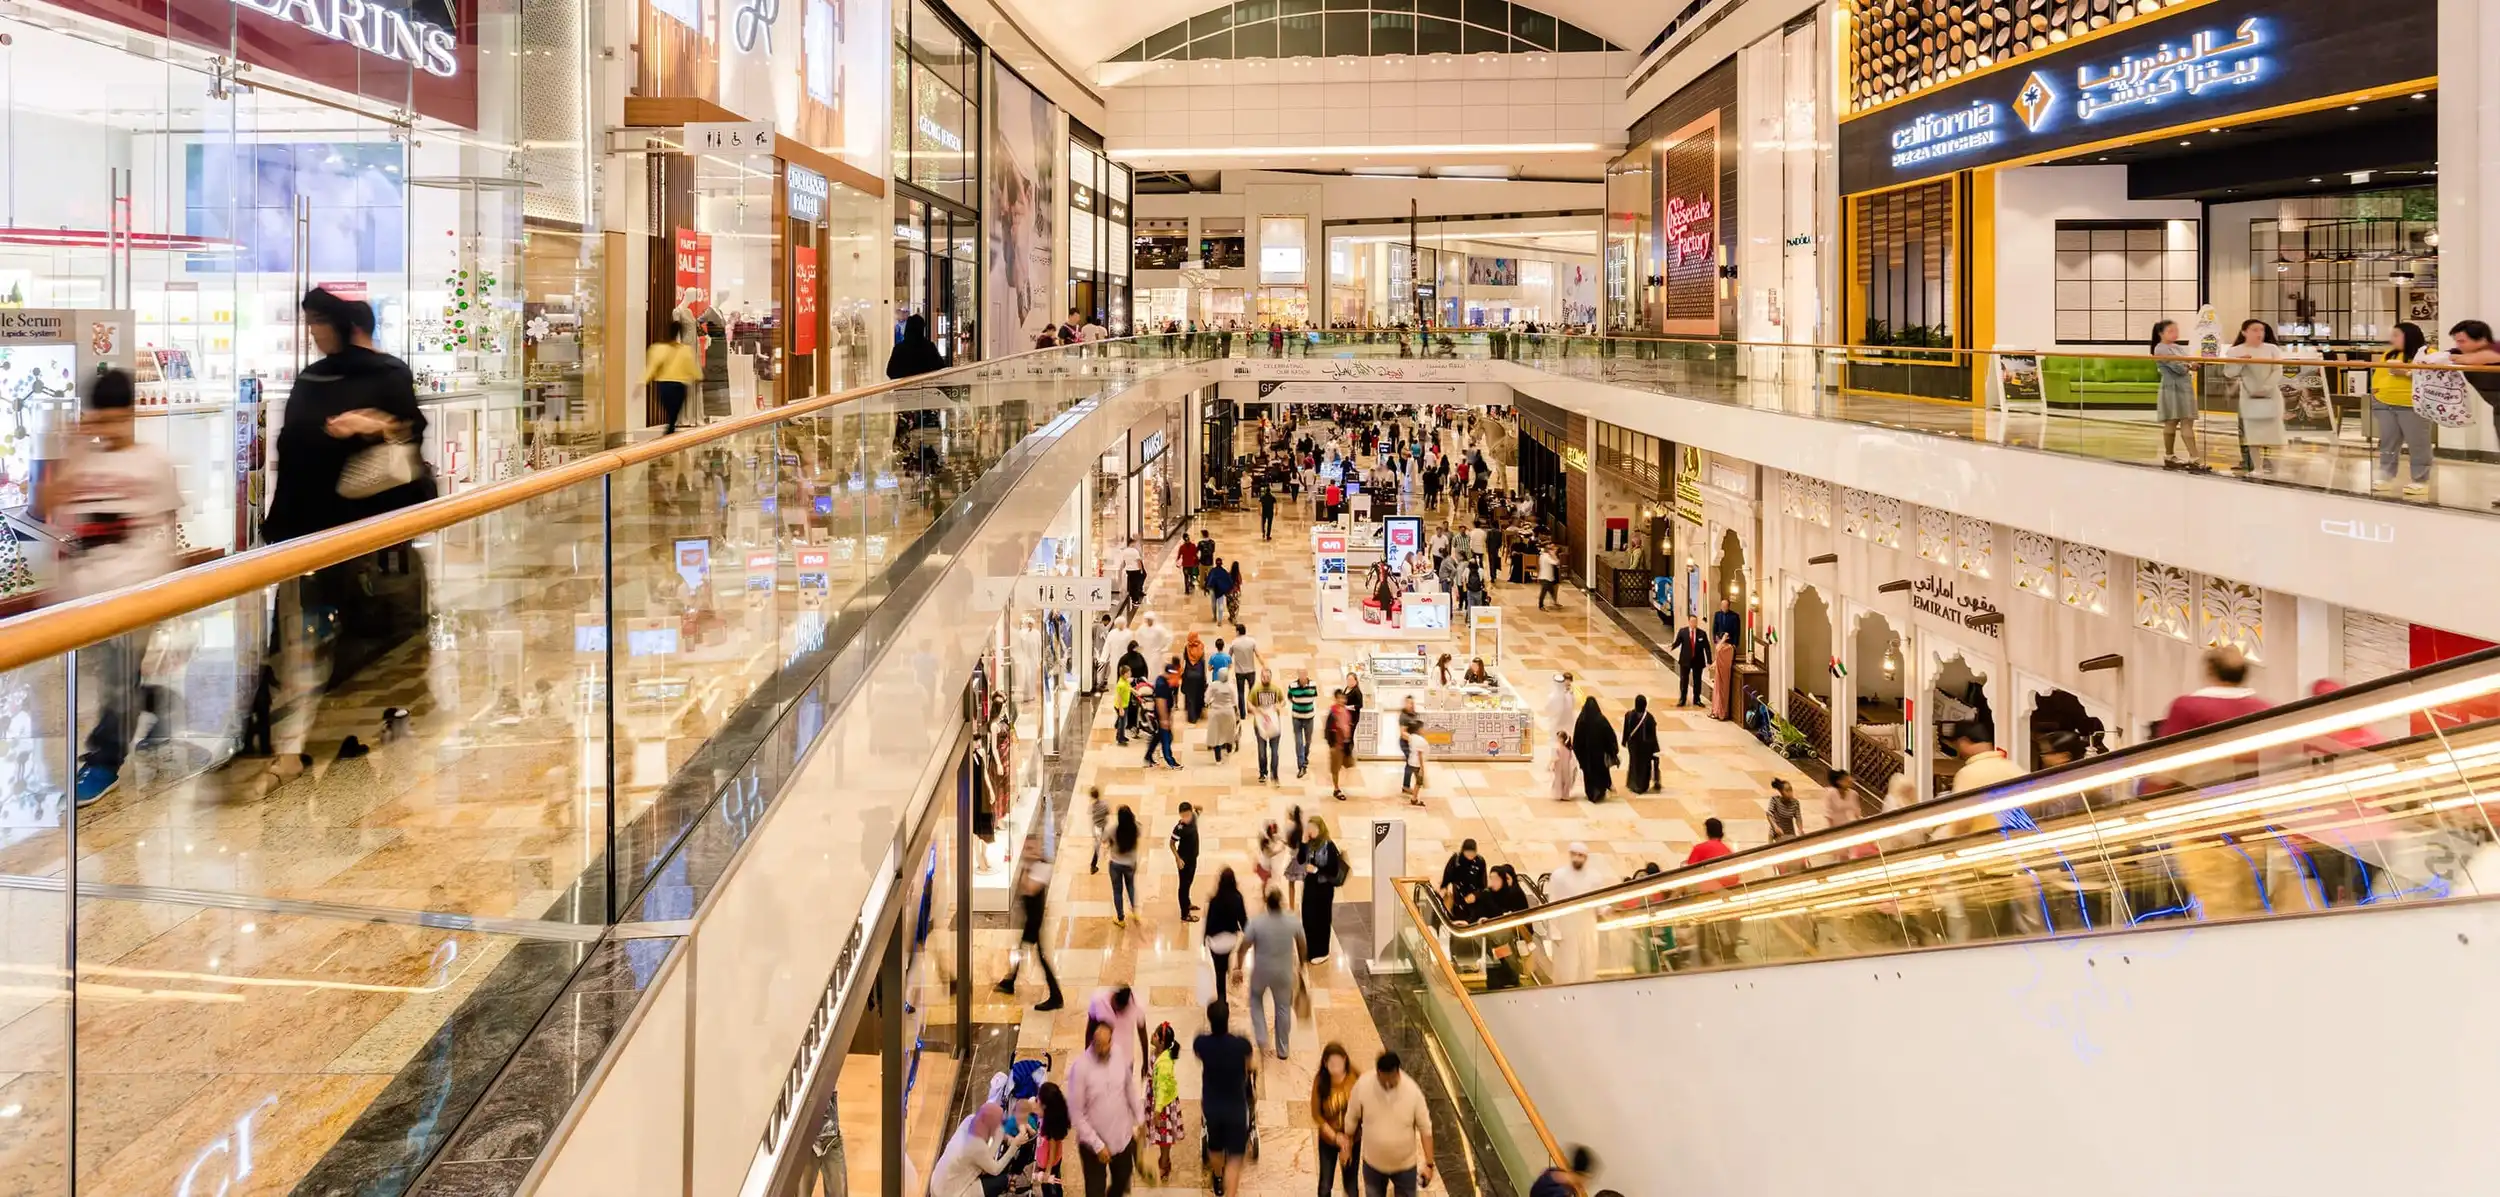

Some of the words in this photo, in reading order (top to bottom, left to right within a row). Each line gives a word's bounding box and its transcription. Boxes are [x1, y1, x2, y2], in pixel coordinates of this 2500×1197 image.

[1892, 100, 1995, 149] california
[1932, 130, 1995, 157] KITCHEN
[1667, 193, 1712, 241] Cheesecake
[680, 238, 697, 251] PART
[1674, 226, 1711, 267] Factory
[679, 254, 705, 273] SALE
[17, 312, 62, 327] Serum
[1260, 383, 1274, 393] GF
[1913, 595, 1961, 625] EMIRATI
[1376, 825, 1388, 835] GF
